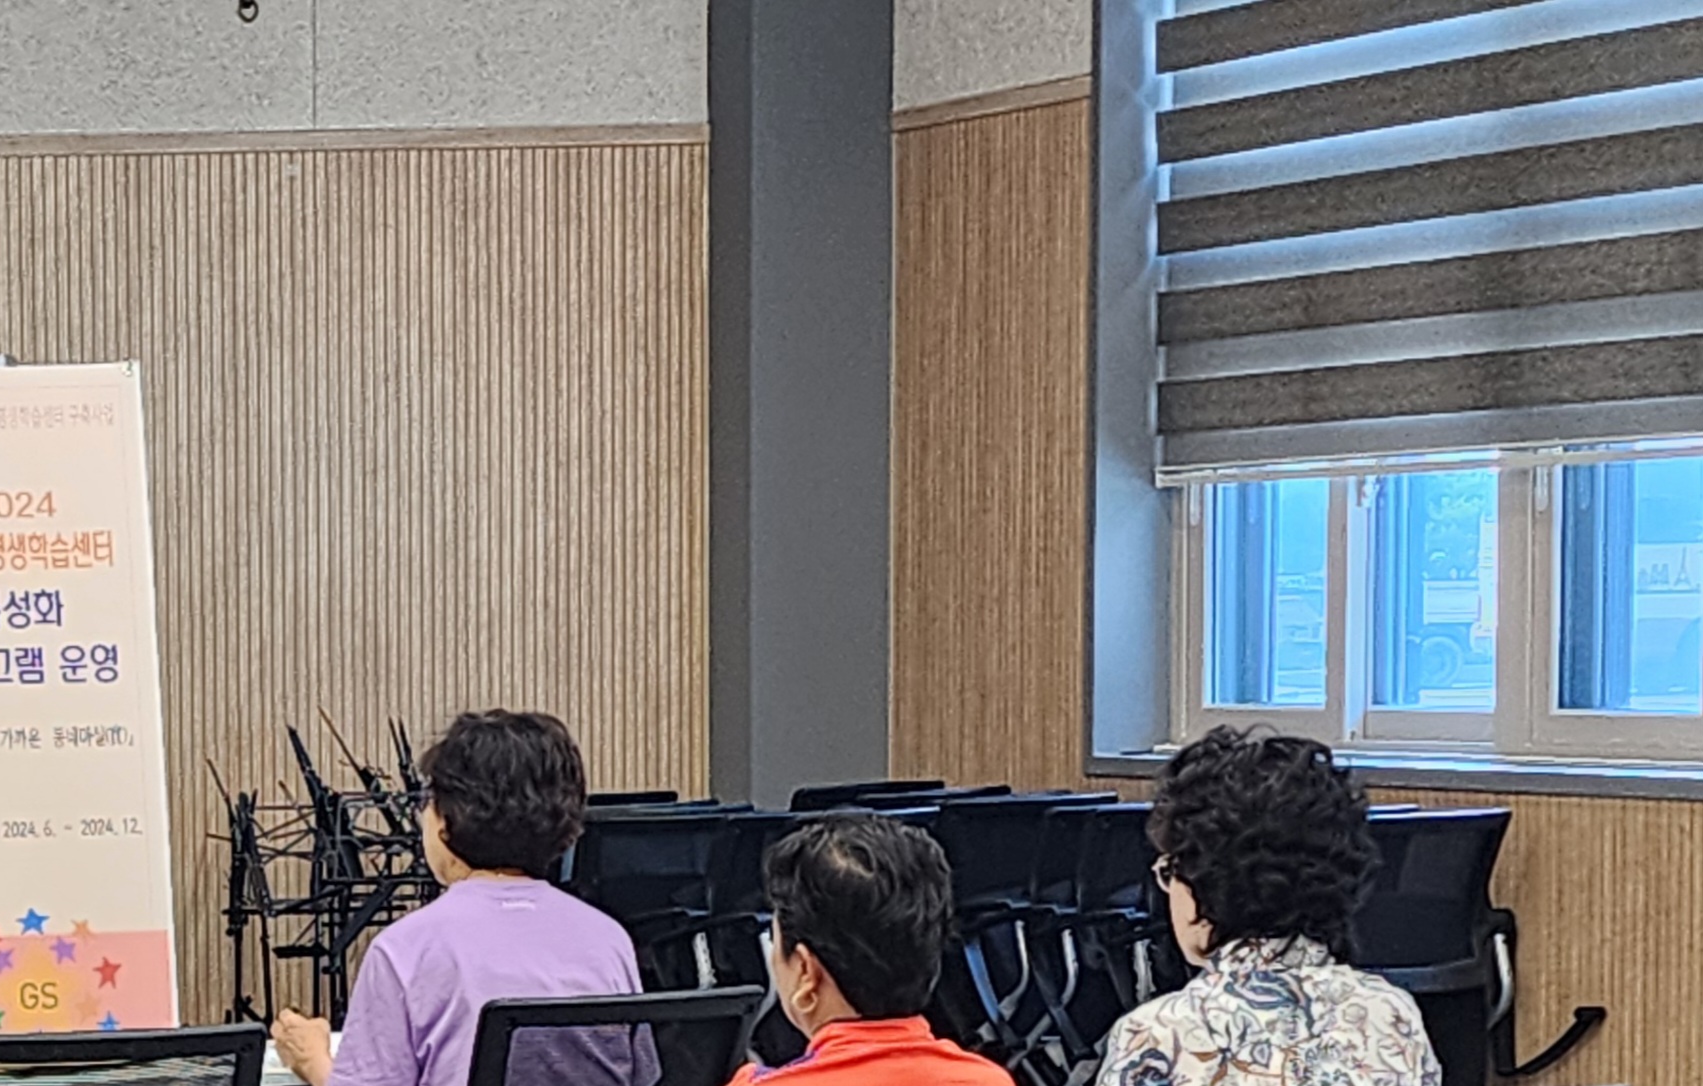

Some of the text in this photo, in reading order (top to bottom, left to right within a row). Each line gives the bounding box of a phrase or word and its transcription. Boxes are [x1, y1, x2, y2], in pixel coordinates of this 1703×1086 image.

[59, 643, 119, 684] 운영
[0, 727, 42, 750] 가까운
[19, 982, 58, 1010] GS
